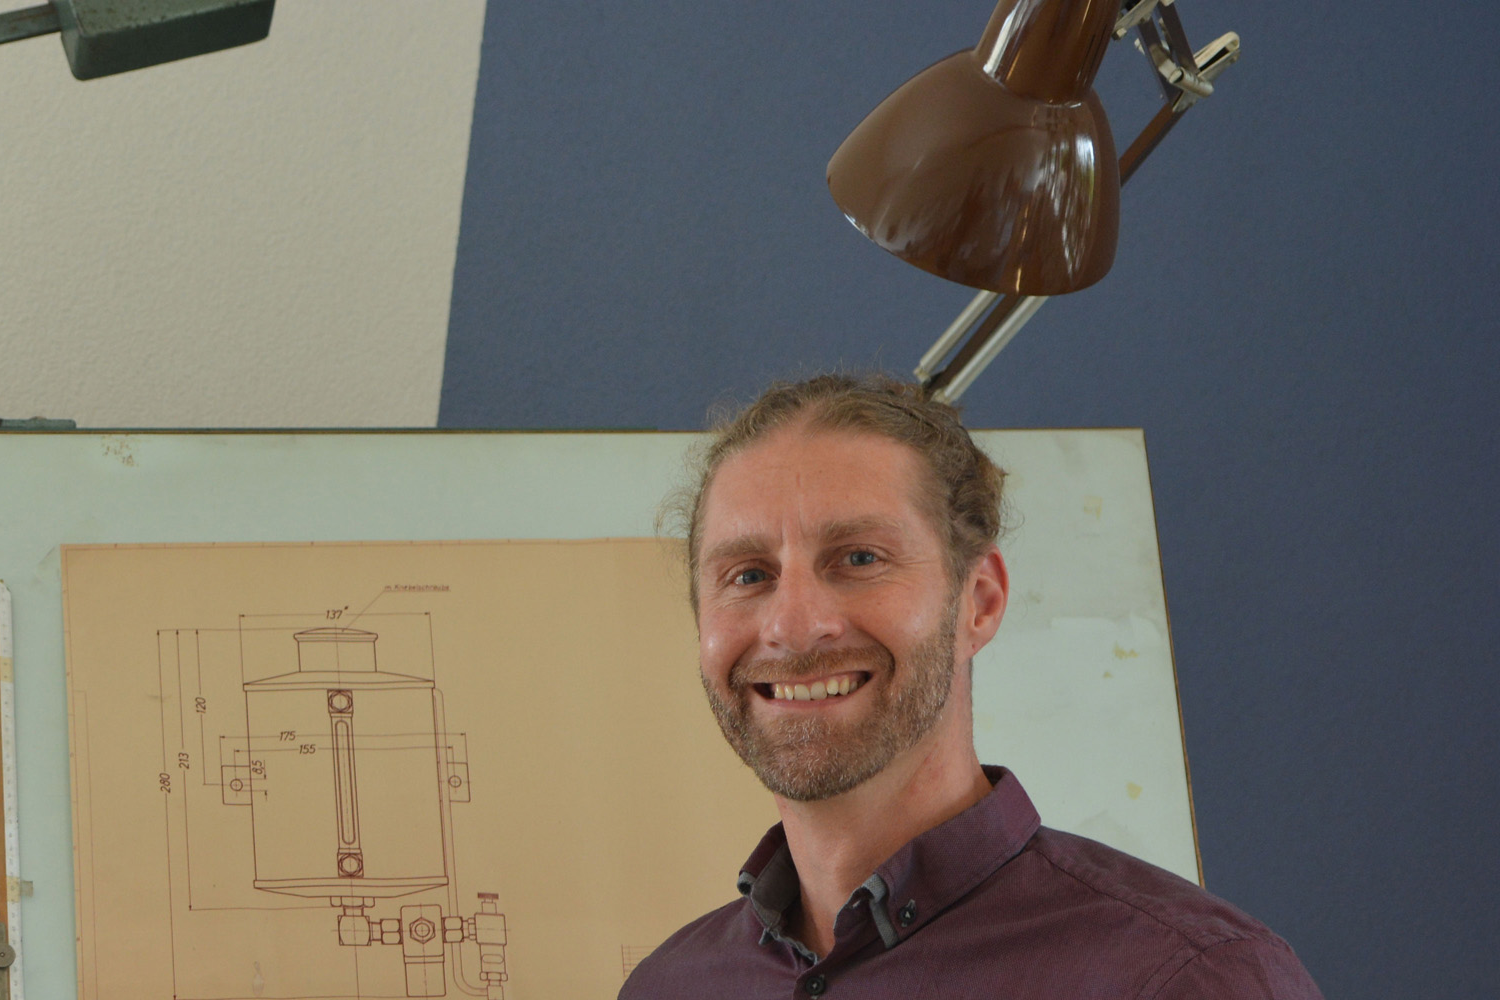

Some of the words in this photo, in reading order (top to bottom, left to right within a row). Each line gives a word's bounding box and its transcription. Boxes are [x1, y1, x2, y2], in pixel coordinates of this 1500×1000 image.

[195, 696, 206, 714] 120
[279, 730, 296, 742] 175
[299, 743, 316, 754] 155
[178, 752, 190, 770] 213
[159, 772, 171, 794] 280
